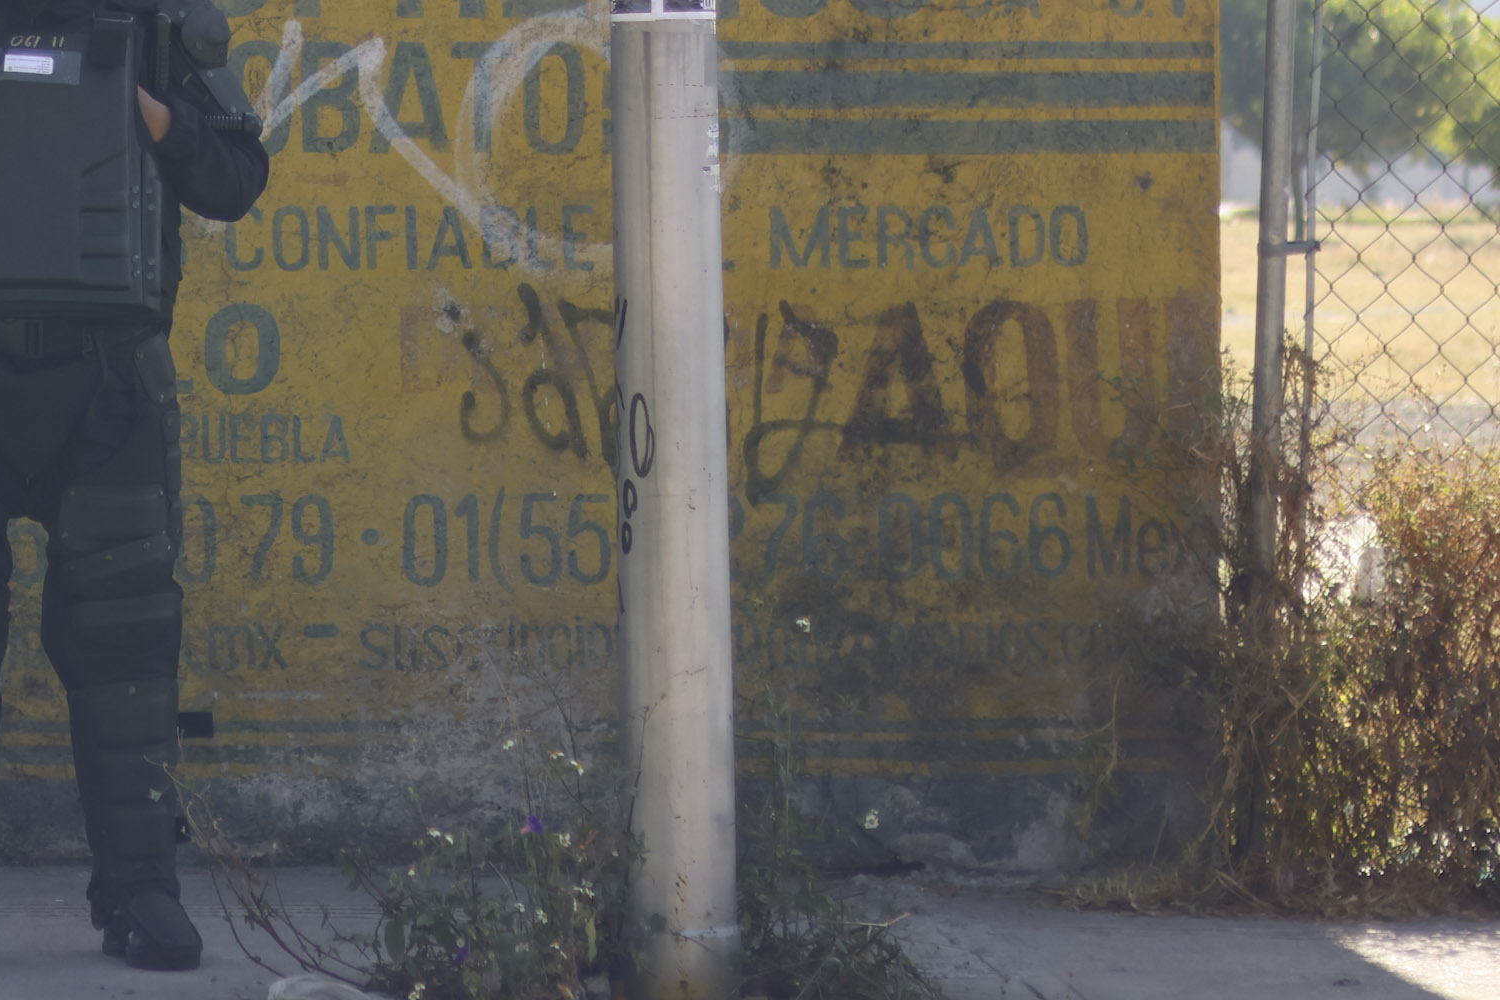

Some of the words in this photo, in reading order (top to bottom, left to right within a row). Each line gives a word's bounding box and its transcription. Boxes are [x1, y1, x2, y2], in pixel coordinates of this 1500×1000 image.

[224, 204, 595, 273] CONFIABLE
[768, 203, 1092, 271] MERCADO
[876, 489, 1073, 583] 0066
